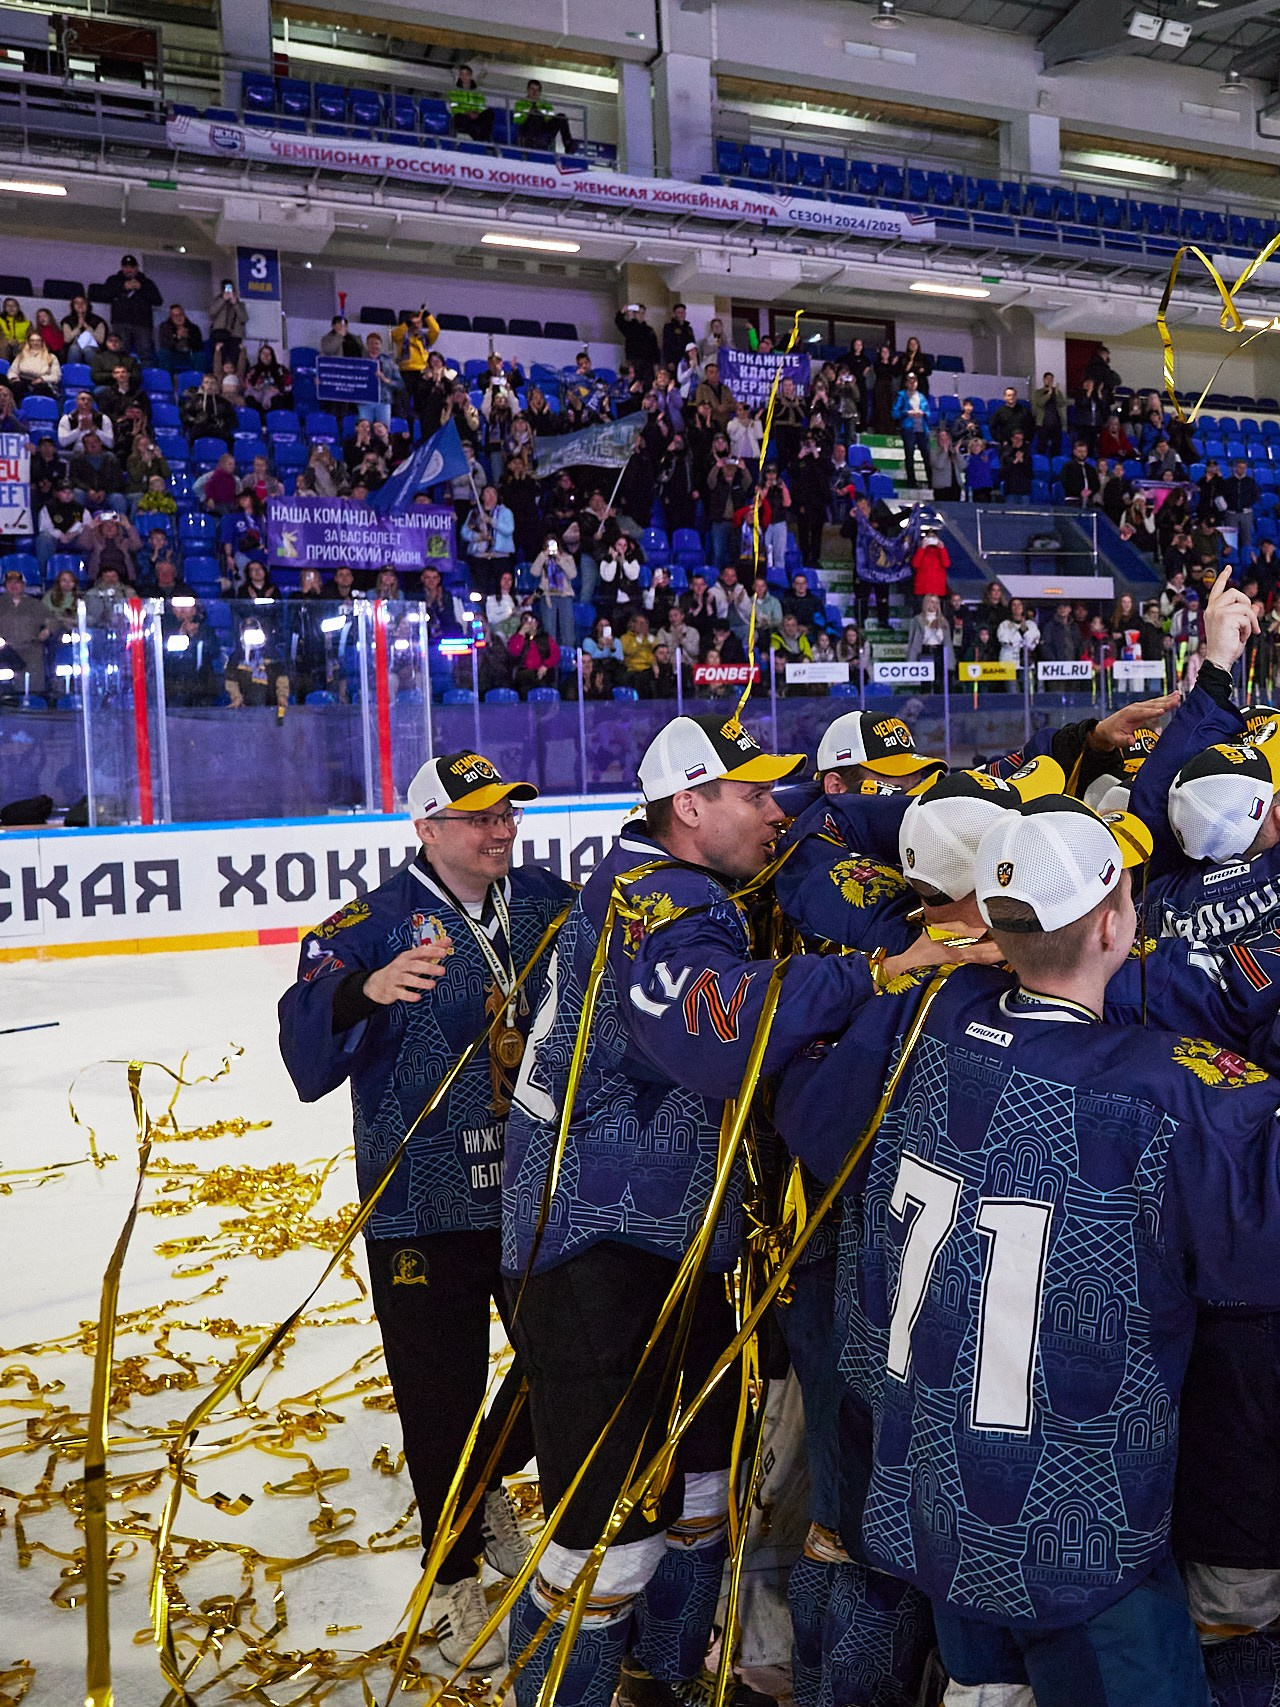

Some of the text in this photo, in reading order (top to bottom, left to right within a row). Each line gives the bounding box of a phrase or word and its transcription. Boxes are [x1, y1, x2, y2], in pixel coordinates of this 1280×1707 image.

[270, 142, 380, 168] ЧЕМПИОНАТ
[385, 157, 455, 177] РОССИИ
[460, 166, 483, 179] ПО
[488, 169, 556, 189] ХОККЕЮ
[574, 181, 647, 200] ЖЕНСКАЯ
[652, 189, 738, 211] ХОККЕЙНАЯ
[742, 201, 777, 218] ЛИГА
[789, 209, 901, 233] СЕЗОН 2024/2025
[251, 253, 267, 278] 3
[728, 350, 800, 367] ПОКАЖИТЕ
[740, 365, 785, 380] КЛАСС
[271, 506, 311, 524] НАША
[314, 508, 378, 526] КОМАНДА
[389, 512, 452, 530] ЧЕМПИОН!
[324, 529, 401, 545] ЗА ВАС БОЛЕЕТ
[306, 544, 421, 564] ПРИОКСКИЙ РАЙОН!
[695, 666, 759, 681] FONBET
[982, 667, 1007, 675] БАНК
[1042, 665, 1088, 677] KHL.RU
[886, 1149, 1055, 1435] 71
